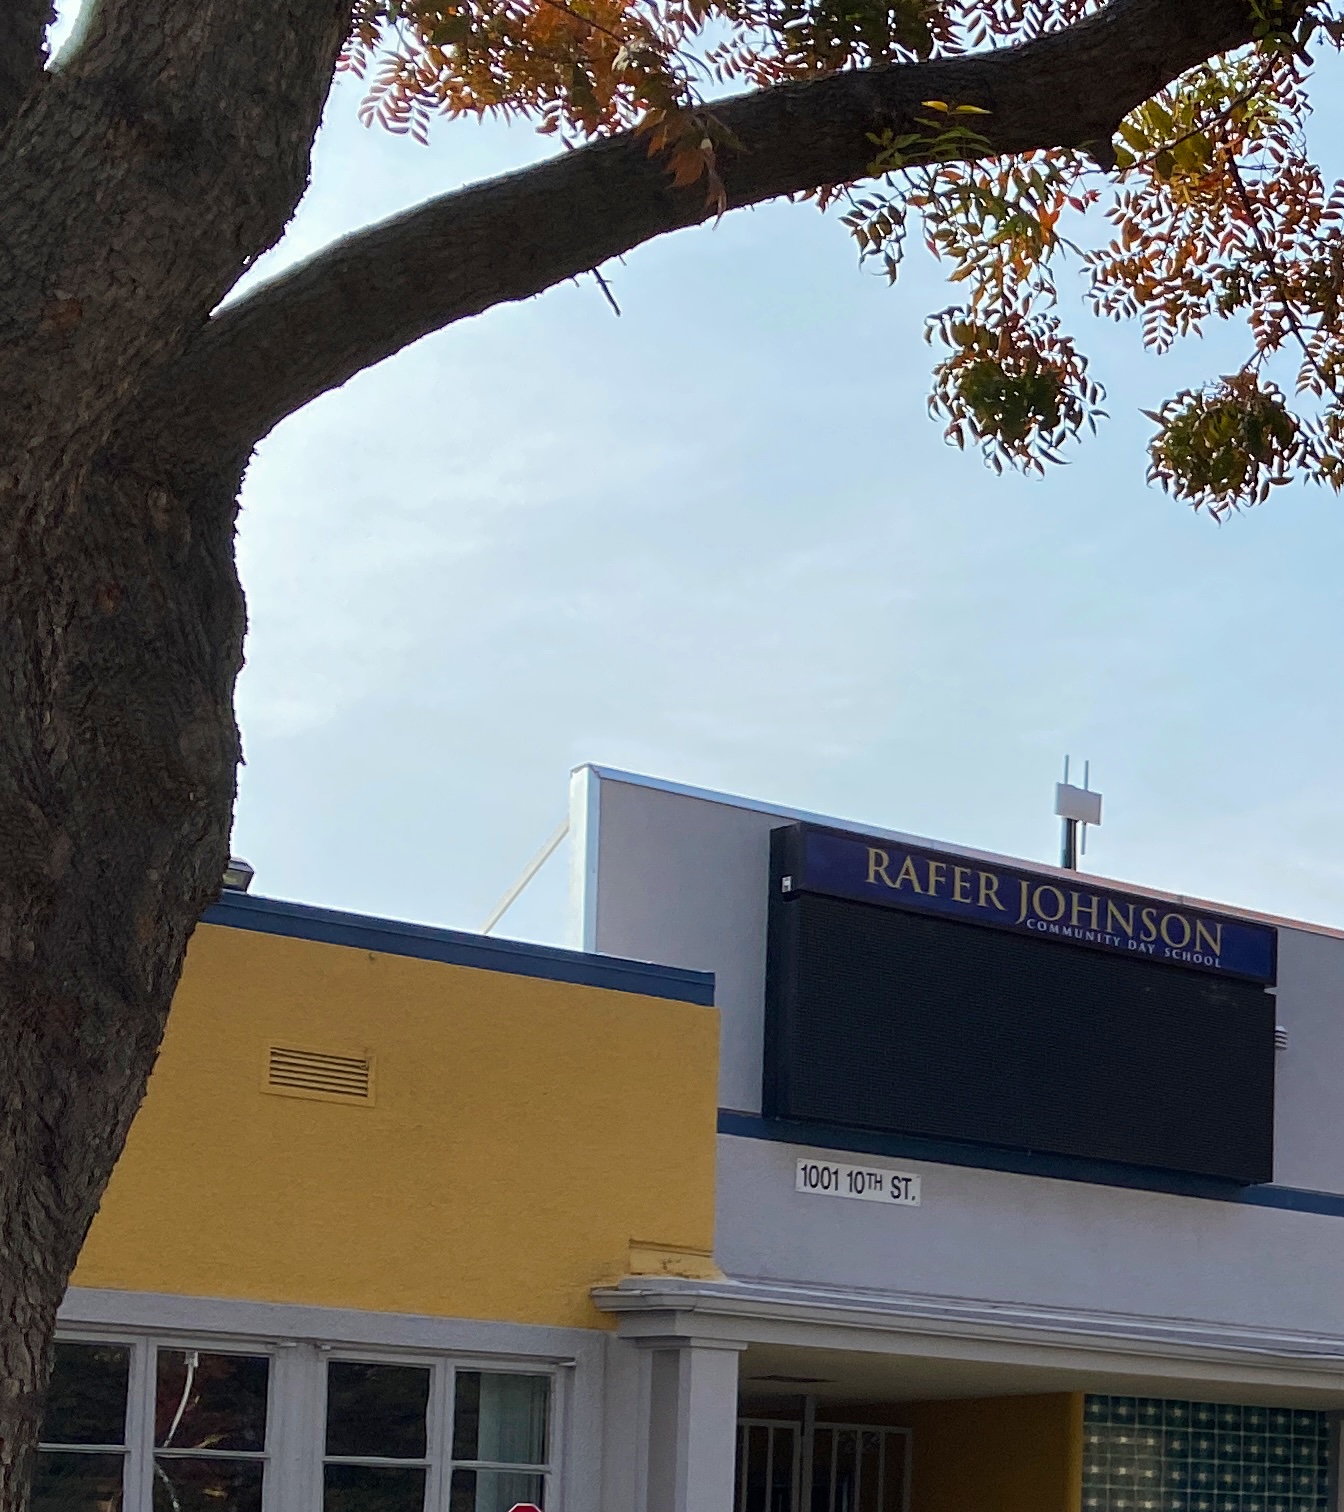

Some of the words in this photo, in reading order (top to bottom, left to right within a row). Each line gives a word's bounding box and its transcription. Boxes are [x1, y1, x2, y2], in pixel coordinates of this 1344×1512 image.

[865, 846, 1007, 912] RAFER
[1014, 879, 1223, 957] JOHNSON
[1026, 918, 1121, 948] COMMUNITY
[1127, 939, 1156, 955] DAY
[1164, 947, 1222, 969] SCHOOL
[801, 1163, 839, 1191] 1001
[847, 1170, 883, 1195] 10TH
[890, 1175, 916, 1201] ST.
